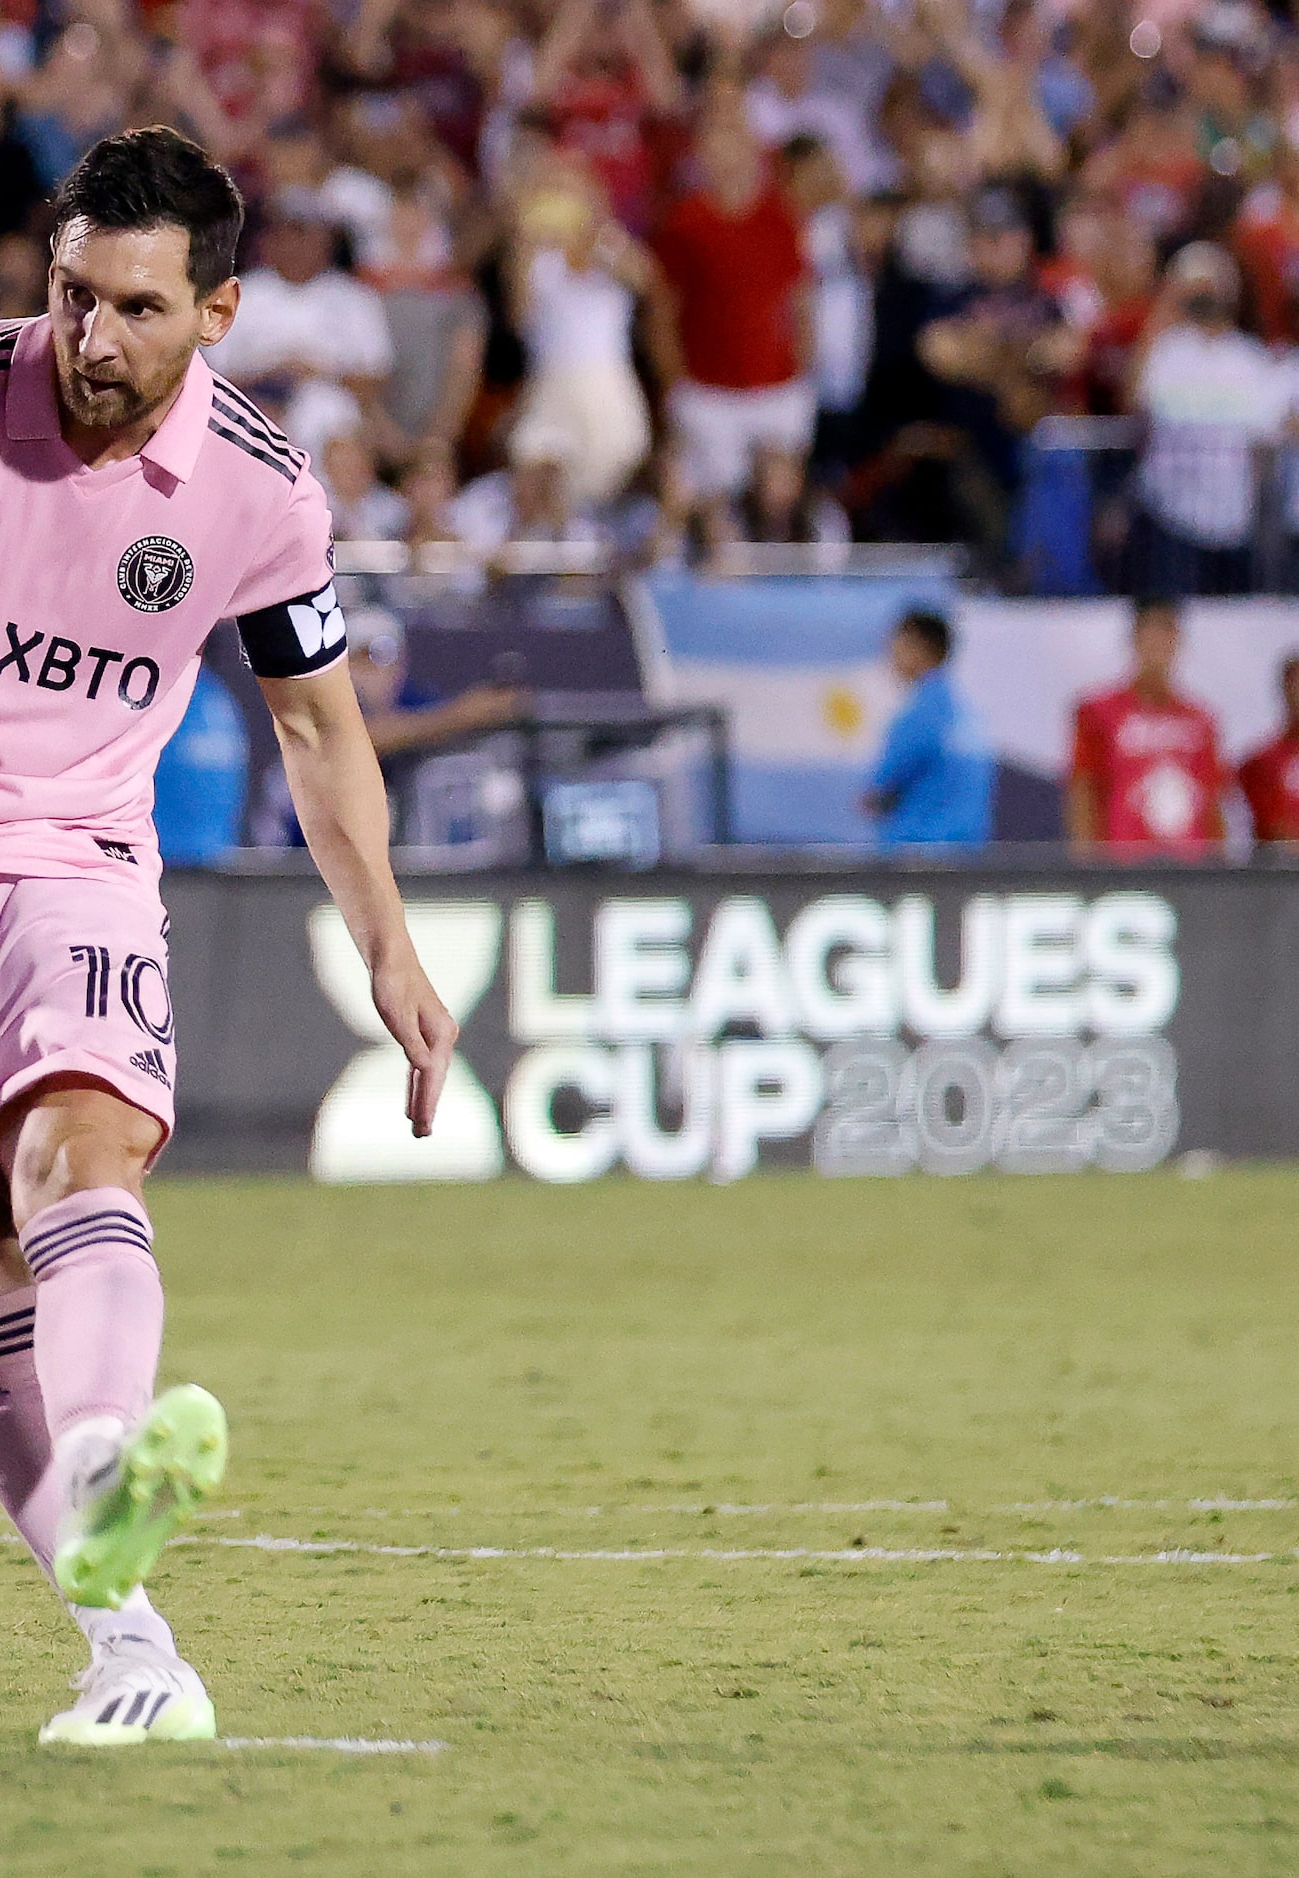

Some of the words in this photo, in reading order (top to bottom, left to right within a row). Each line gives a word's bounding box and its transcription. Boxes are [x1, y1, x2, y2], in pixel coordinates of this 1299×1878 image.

[143, 553, 175, 567] MIAMI
[68, 944, 173, 1046] 10
[508, 892, 1182, 1042] LEAGUES
[504, 1040, 828, 1184] CUP
[812, 1038, 1182, 1176] 2023
